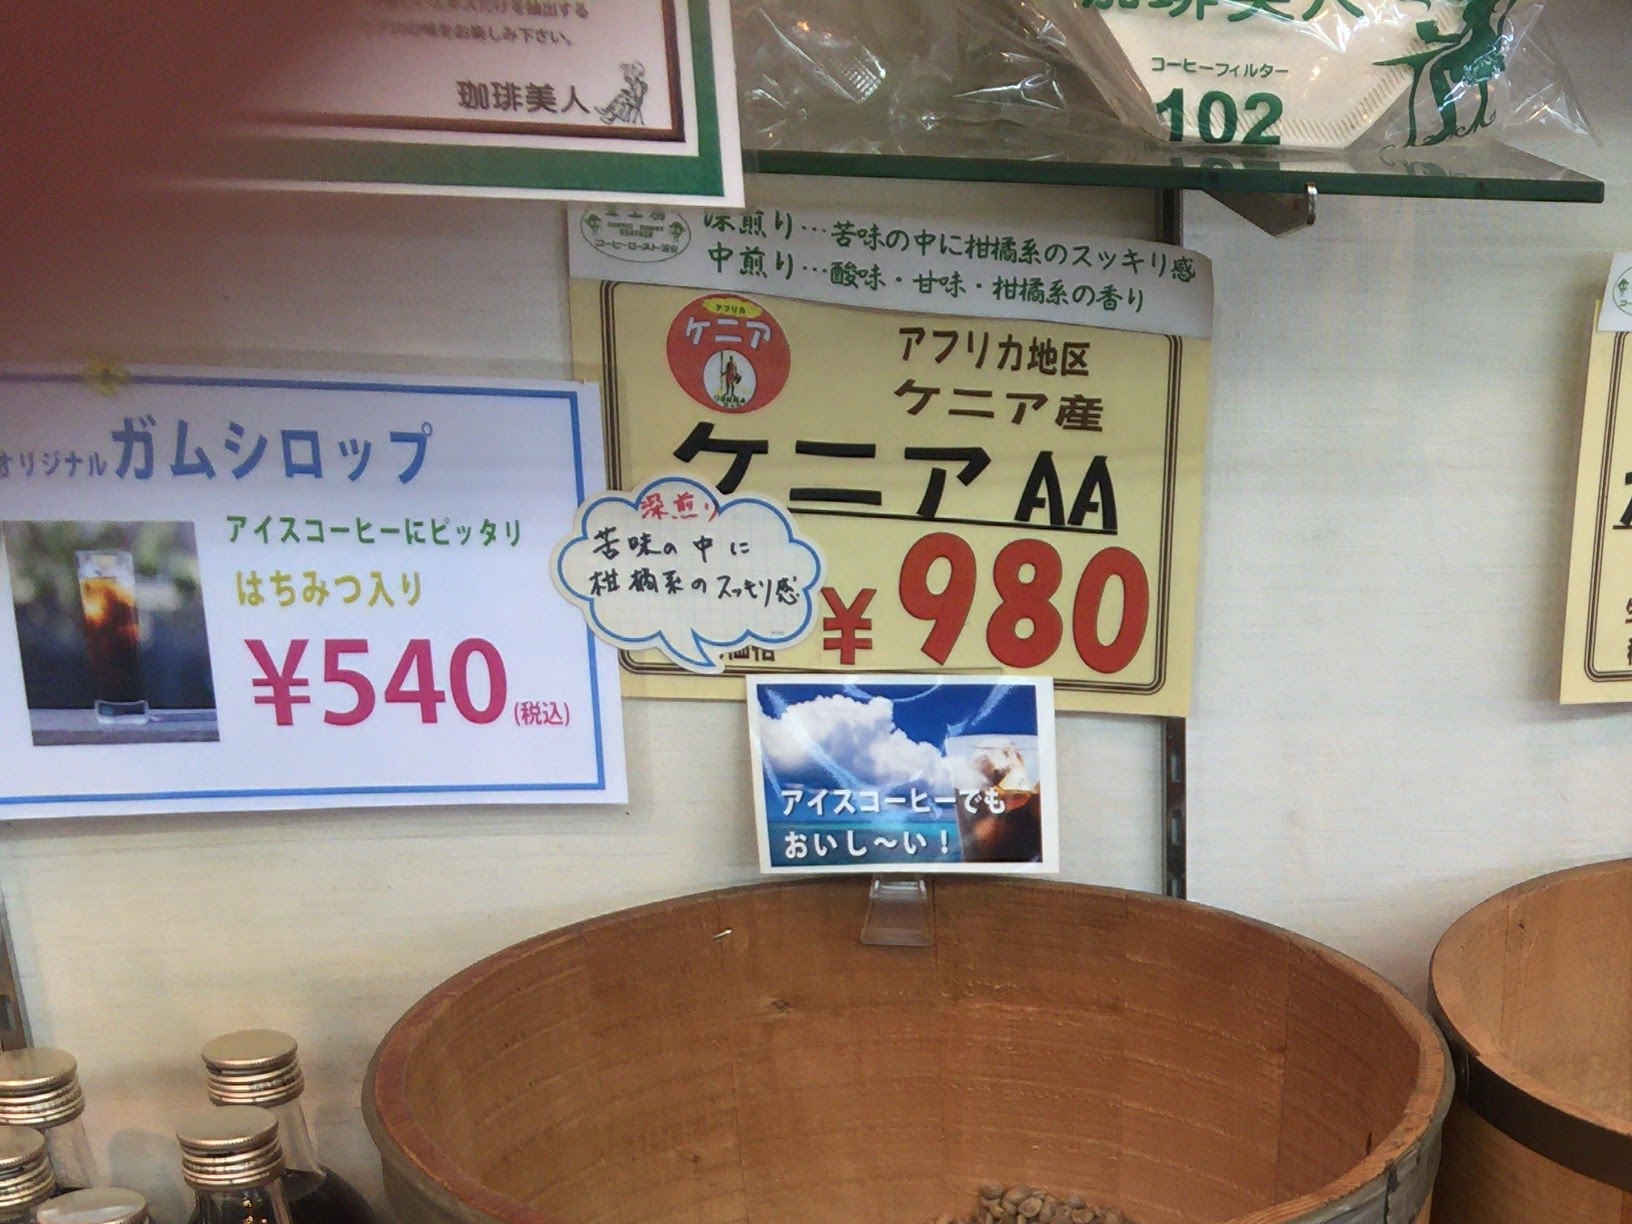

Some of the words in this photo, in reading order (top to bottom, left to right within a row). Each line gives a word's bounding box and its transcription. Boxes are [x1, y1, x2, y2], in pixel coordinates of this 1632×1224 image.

[1151, 57, 1289, 79] コーヒーフィルター
[455, 80, 591, 115] 珈琲美人
[1155, 87, 1284, 146] 102
[686, 316, 771, 349] ケニア
[899, 327, 1091, 378] アフリカ地区
[894, 378, 1104, 432] ケニア産
[0, 451, 108, 479] オリジナル
[111, 415, 433, 485] ガムシロップ
[226, 515, 521, 548] アイスコーヒーにピッタリ
[236, 571, 423, 607] はちみつ入り
[244, 637, 508, 727] ¥540
[514, 701, 570, 727] (税込)
[781, 787, 1005, 817] アイスコーヒーでも
